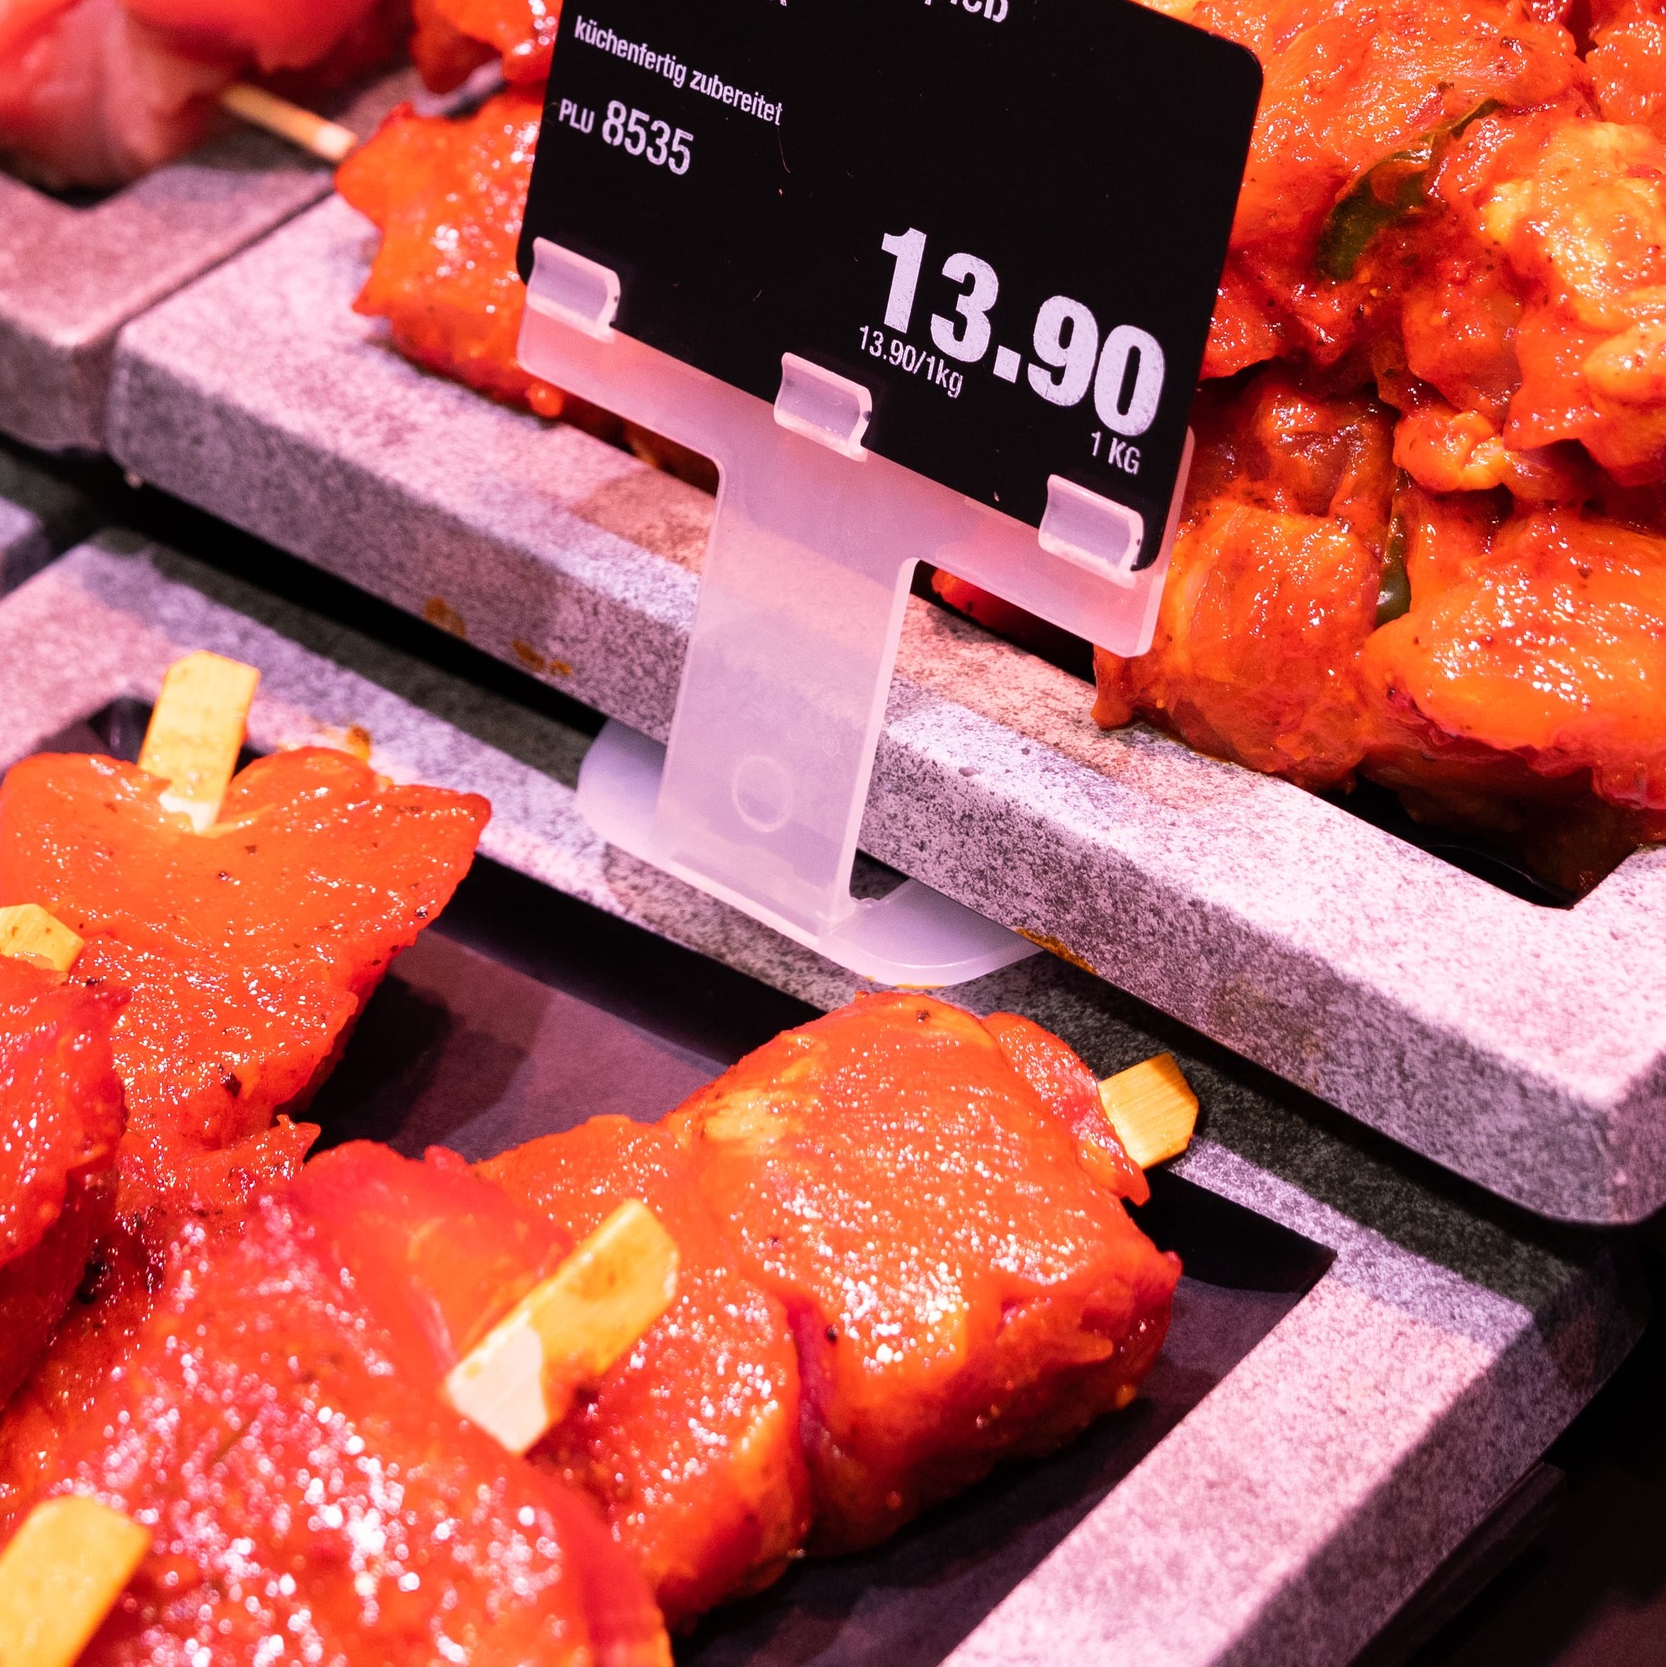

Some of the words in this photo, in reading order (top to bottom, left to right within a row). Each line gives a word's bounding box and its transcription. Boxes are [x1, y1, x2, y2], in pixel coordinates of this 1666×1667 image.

[574, 15, 687, 89] küchenfertig
[689, 70, 783, 126] zubereitet
[558, 98, 595, 134] PLU
[602, 100, 694, 175] 8535
[859, 325, 964, 399] 13.90/1kg
[882, 228, 1164, 436] 13.90
[1091, 431, 1101, 457] 1
[1107, 437, 1141, 475] KG
